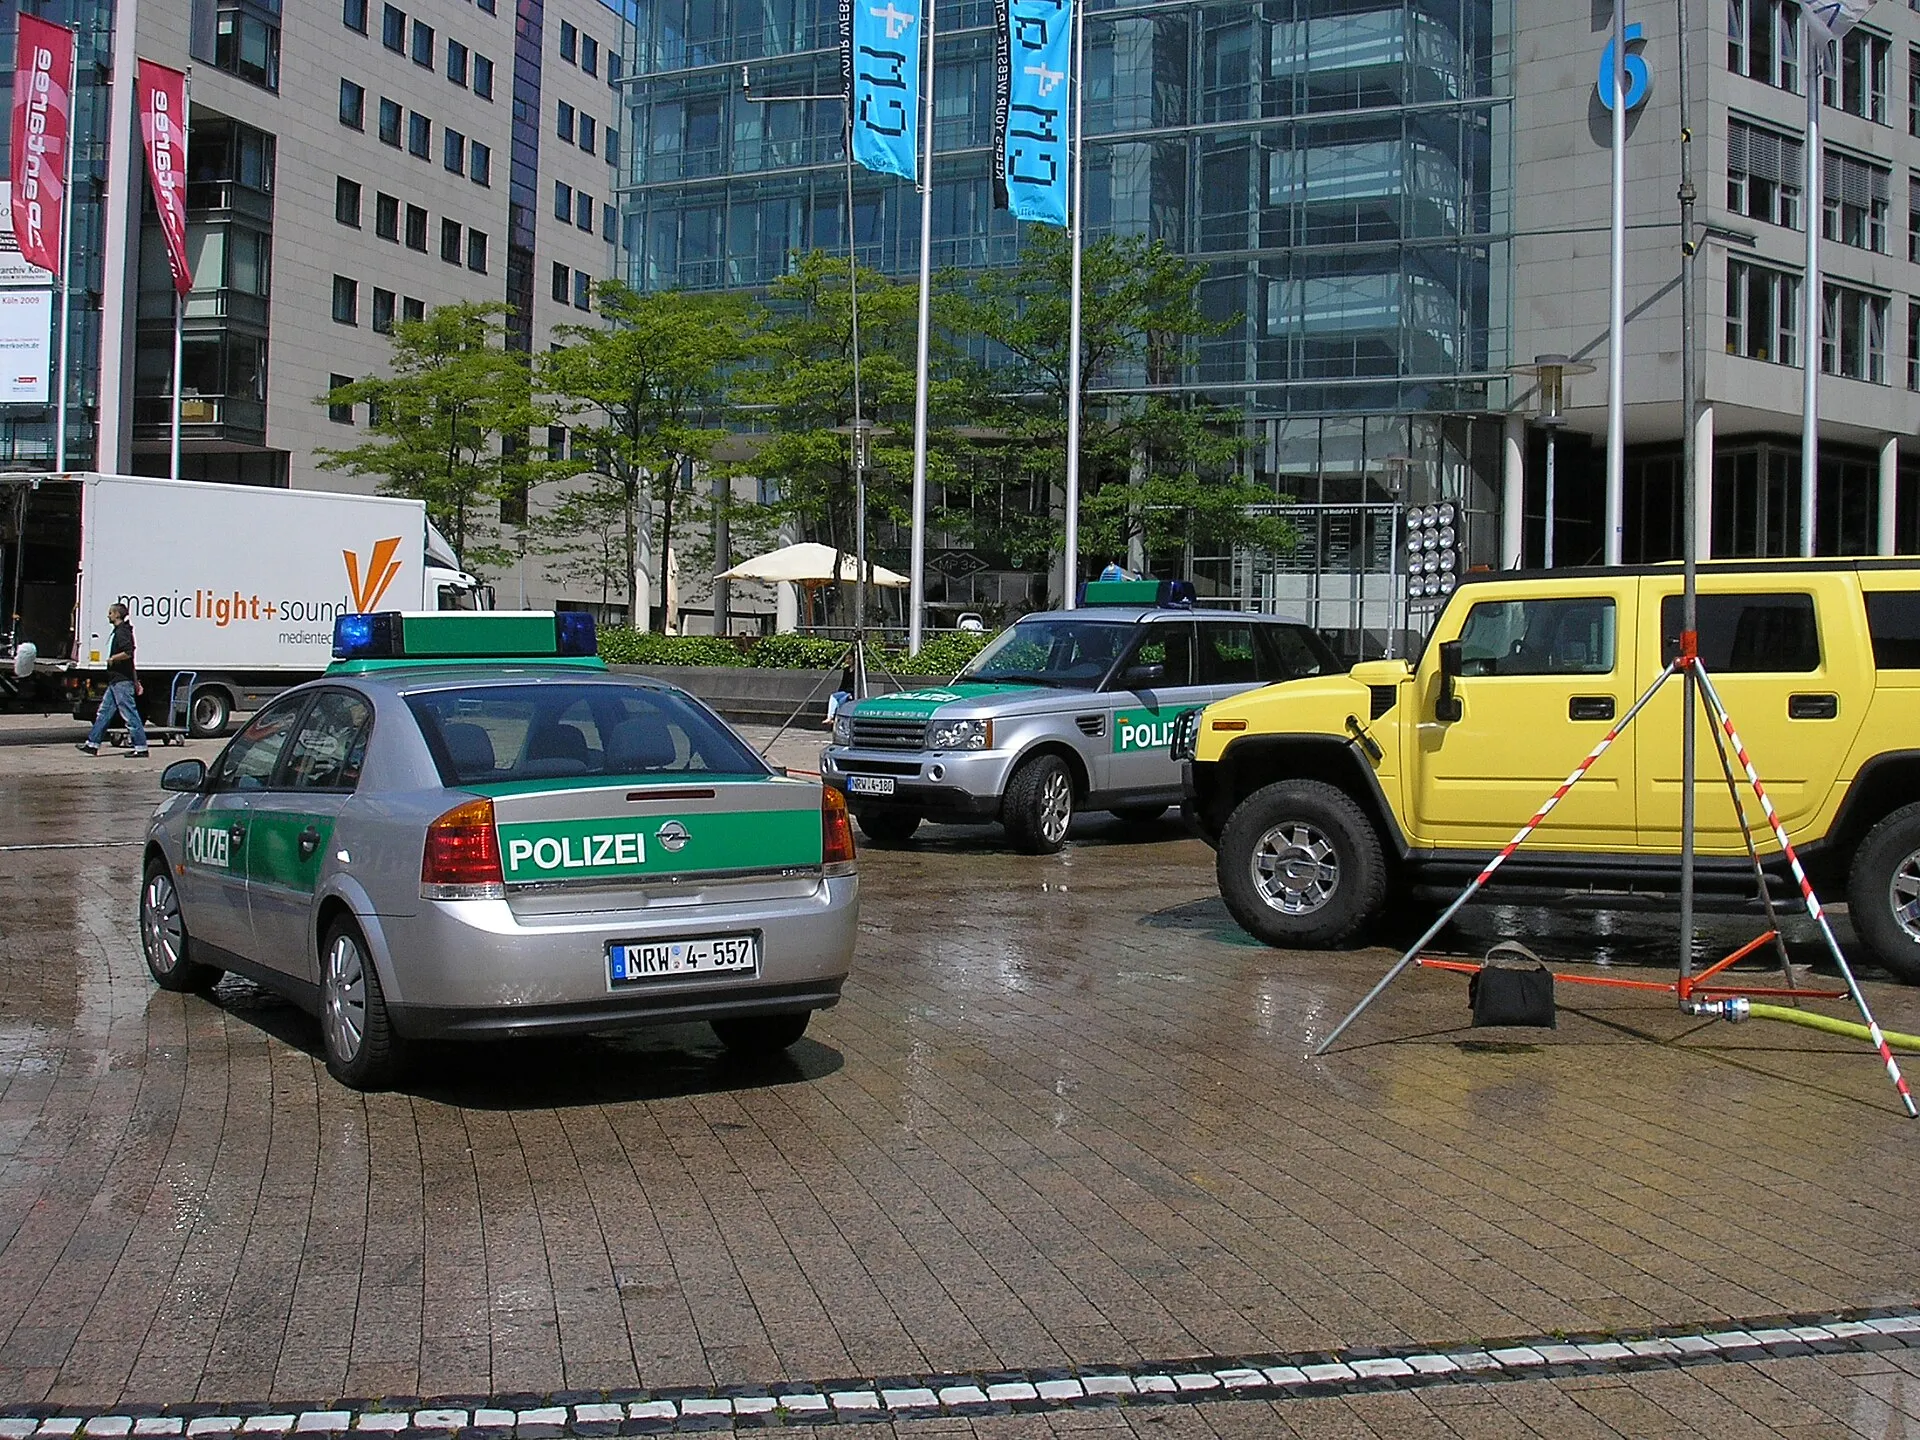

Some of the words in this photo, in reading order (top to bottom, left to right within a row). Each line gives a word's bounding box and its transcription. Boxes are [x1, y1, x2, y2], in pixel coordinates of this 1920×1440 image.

[1598, 22, 1652, 112] 6
[20, 296, 39, 304] 2009
[939, 561, 959, 570] MP
[960, 561, 977, 571] 34
[1121, 720, 1190, 750] POLIZ
[185, 825, 230, 868] POLIZEI
[509, 832, 646, 872] POLIZEI
[628, 946, 669, 974] NRW
